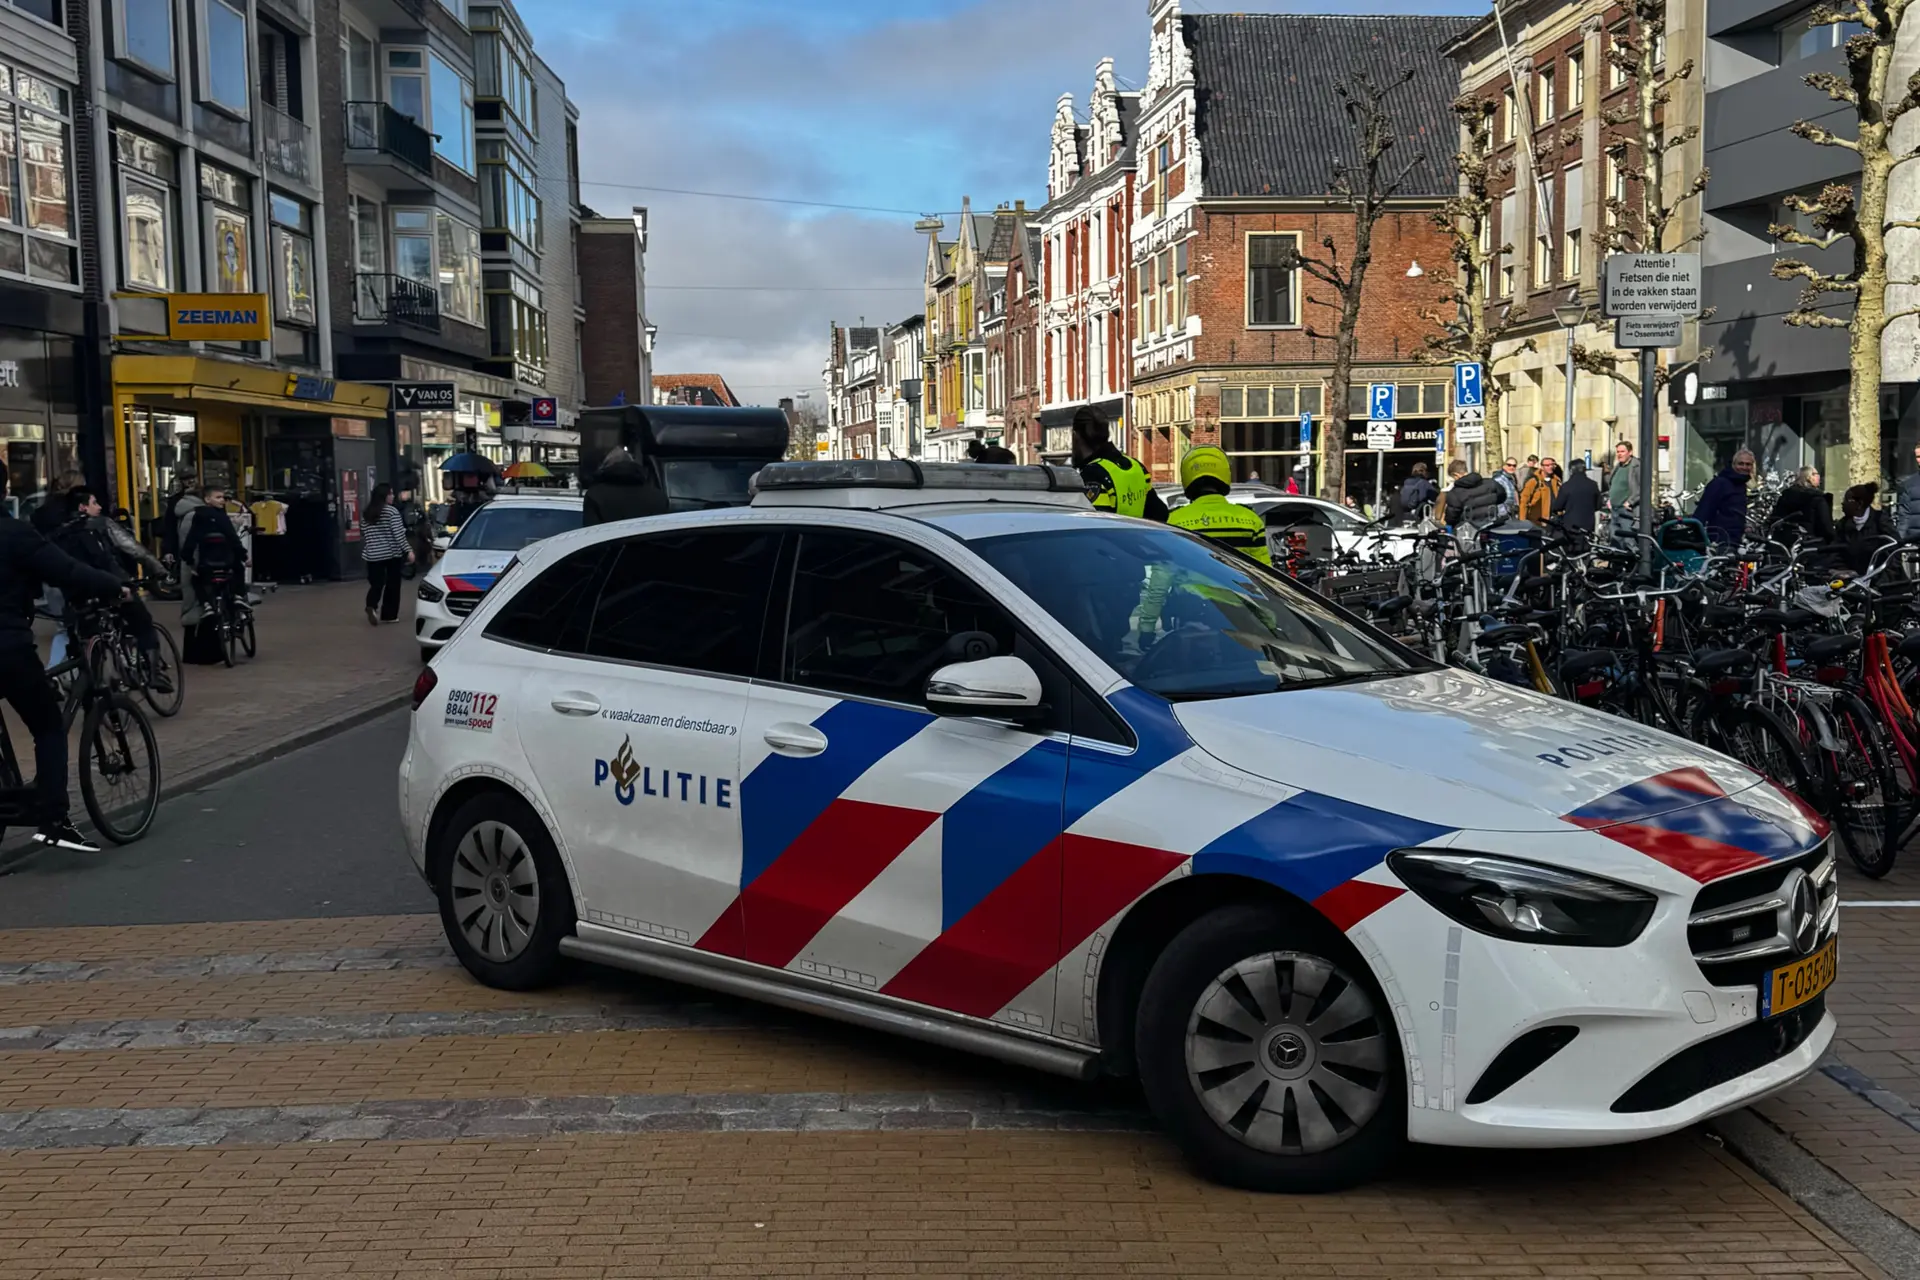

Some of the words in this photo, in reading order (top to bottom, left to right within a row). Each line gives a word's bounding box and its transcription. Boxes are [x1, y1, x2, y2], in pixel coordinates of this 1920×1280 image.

[1634, 258, 1670, 268] Attentie
[1620, 273, 1653, 282] Fietsen
[1655, 272, 1669, 282] die
[1672, 272, 1690, 281] niet
[1612, 287, 1620, 296] in
[1623, 287, 1635, 296] de
[1637, 287, 1668, 296] vakken
[1671, 287, 1696, 296] staan
[1611, 301, 1646, 311] worden
[1649, 300, 1697, 312] verwijderd
[177, 310, 258, 324] ZEEMAN
[1625, 321, 1641, 329] Fiets
[1462, 366, 1476, 389] P
[417, 390, 438, 400] VAN
[439, 389, 453, 400] OS
[1375, 387, 1389, 406] P
[1302, 415, 1308, 430] P
[1404, 430, 1438, 440] BEANS
[448, 689, 473, 703] 0900
[445, 703, 469, 717] 8844
[472, 692, 498, 716] 112
[661, 716, 674, 728] en
[1535, 734, 1662, 769] POLITIE
[594, 758, 732, 809] POLITIE
